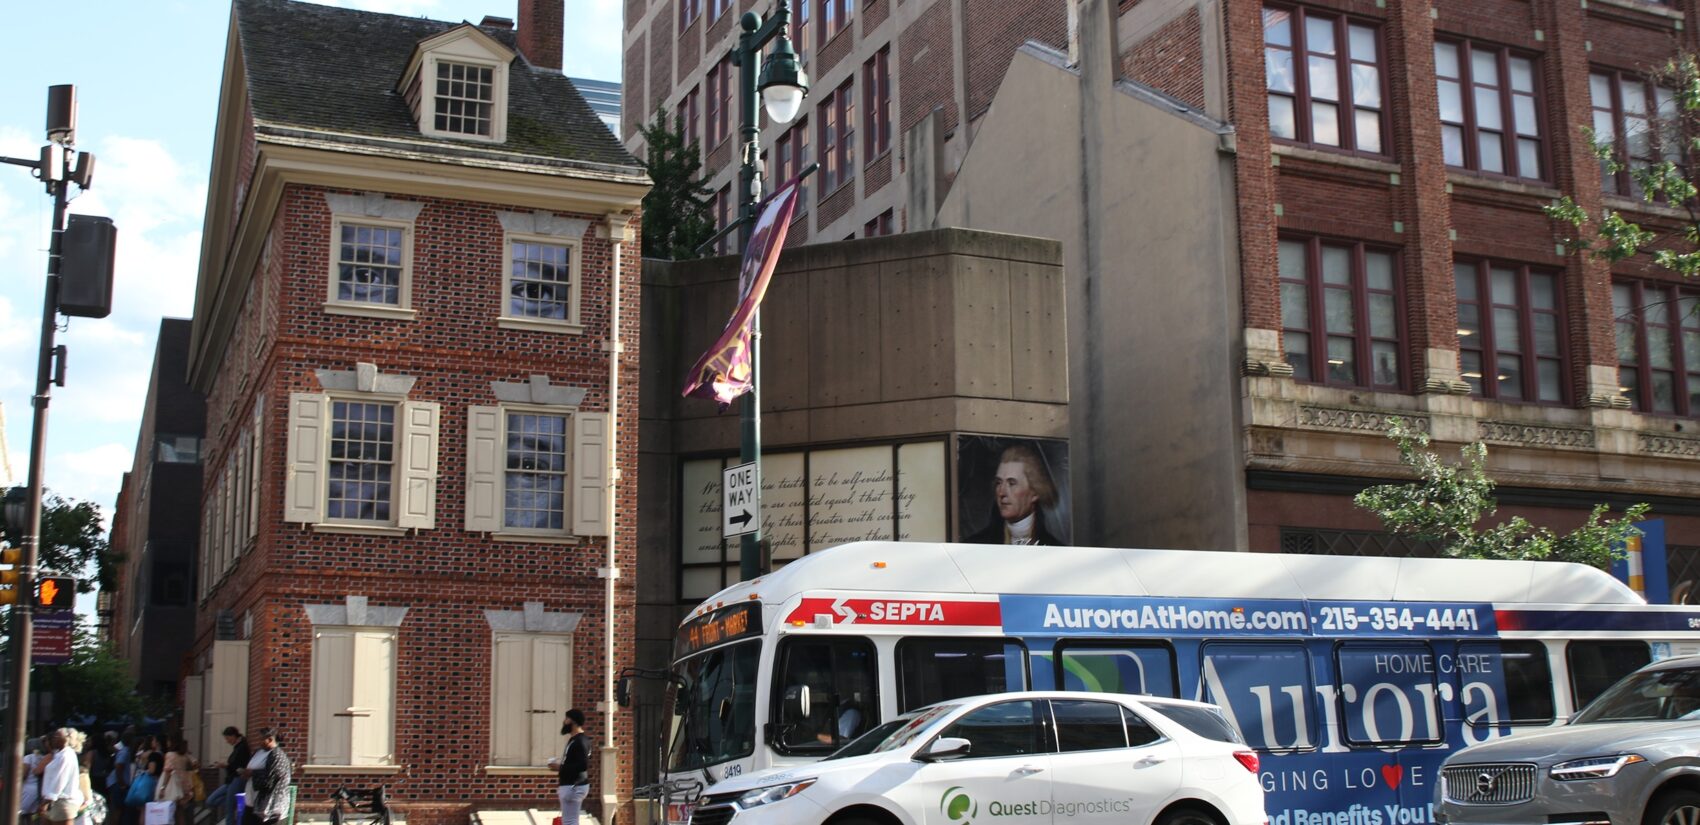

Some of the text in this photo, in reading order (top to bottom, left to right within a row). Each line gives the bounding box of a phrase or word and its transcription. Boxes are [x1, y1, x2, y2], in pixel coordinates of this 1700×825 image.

[730, 469, 752, 489] ONE
[815, 475, 824, 487] to
[828, 472, 838, 485] be
[729, 488, 753, 507] WAY
[859, 489, 892, 503] that
[761, 514, 775, 535] by
[848, 508, 876, 523] with
[870, 602, 945, 621] SEPTA
[1043, 604, 1478, 630] AuroraAtHome.com 215-354-4441
[1375, 654, 1491, 674] HOME CARE
[1194, 655, 1510, 756] Aurora
[724, 764, 741, 779] 8419
[1260, 769, 1328, 793] GING
[989, 801, 1037, 816] Quest
[1294, 804, 1382, 825] Benefits
[1385, 804, 1425, 825] You
